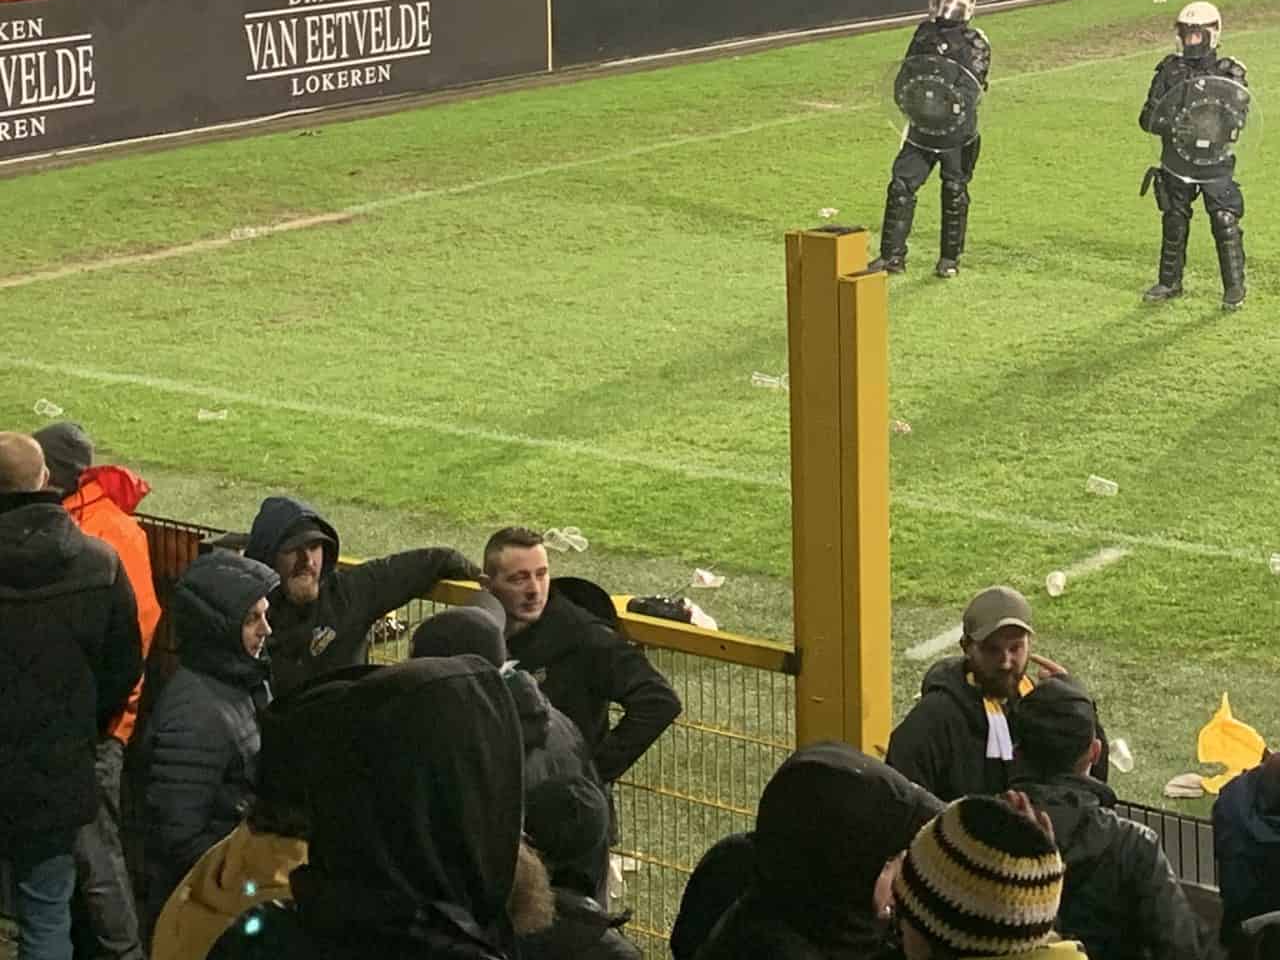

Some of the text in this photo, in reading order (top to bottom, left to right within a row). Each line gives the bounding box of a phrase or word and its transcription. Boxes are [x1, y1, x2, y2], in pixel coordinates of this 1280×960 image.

[245, 1, 432, 72] VAN EETVELDE
[291, 63, 392, 96] LOKEREN
